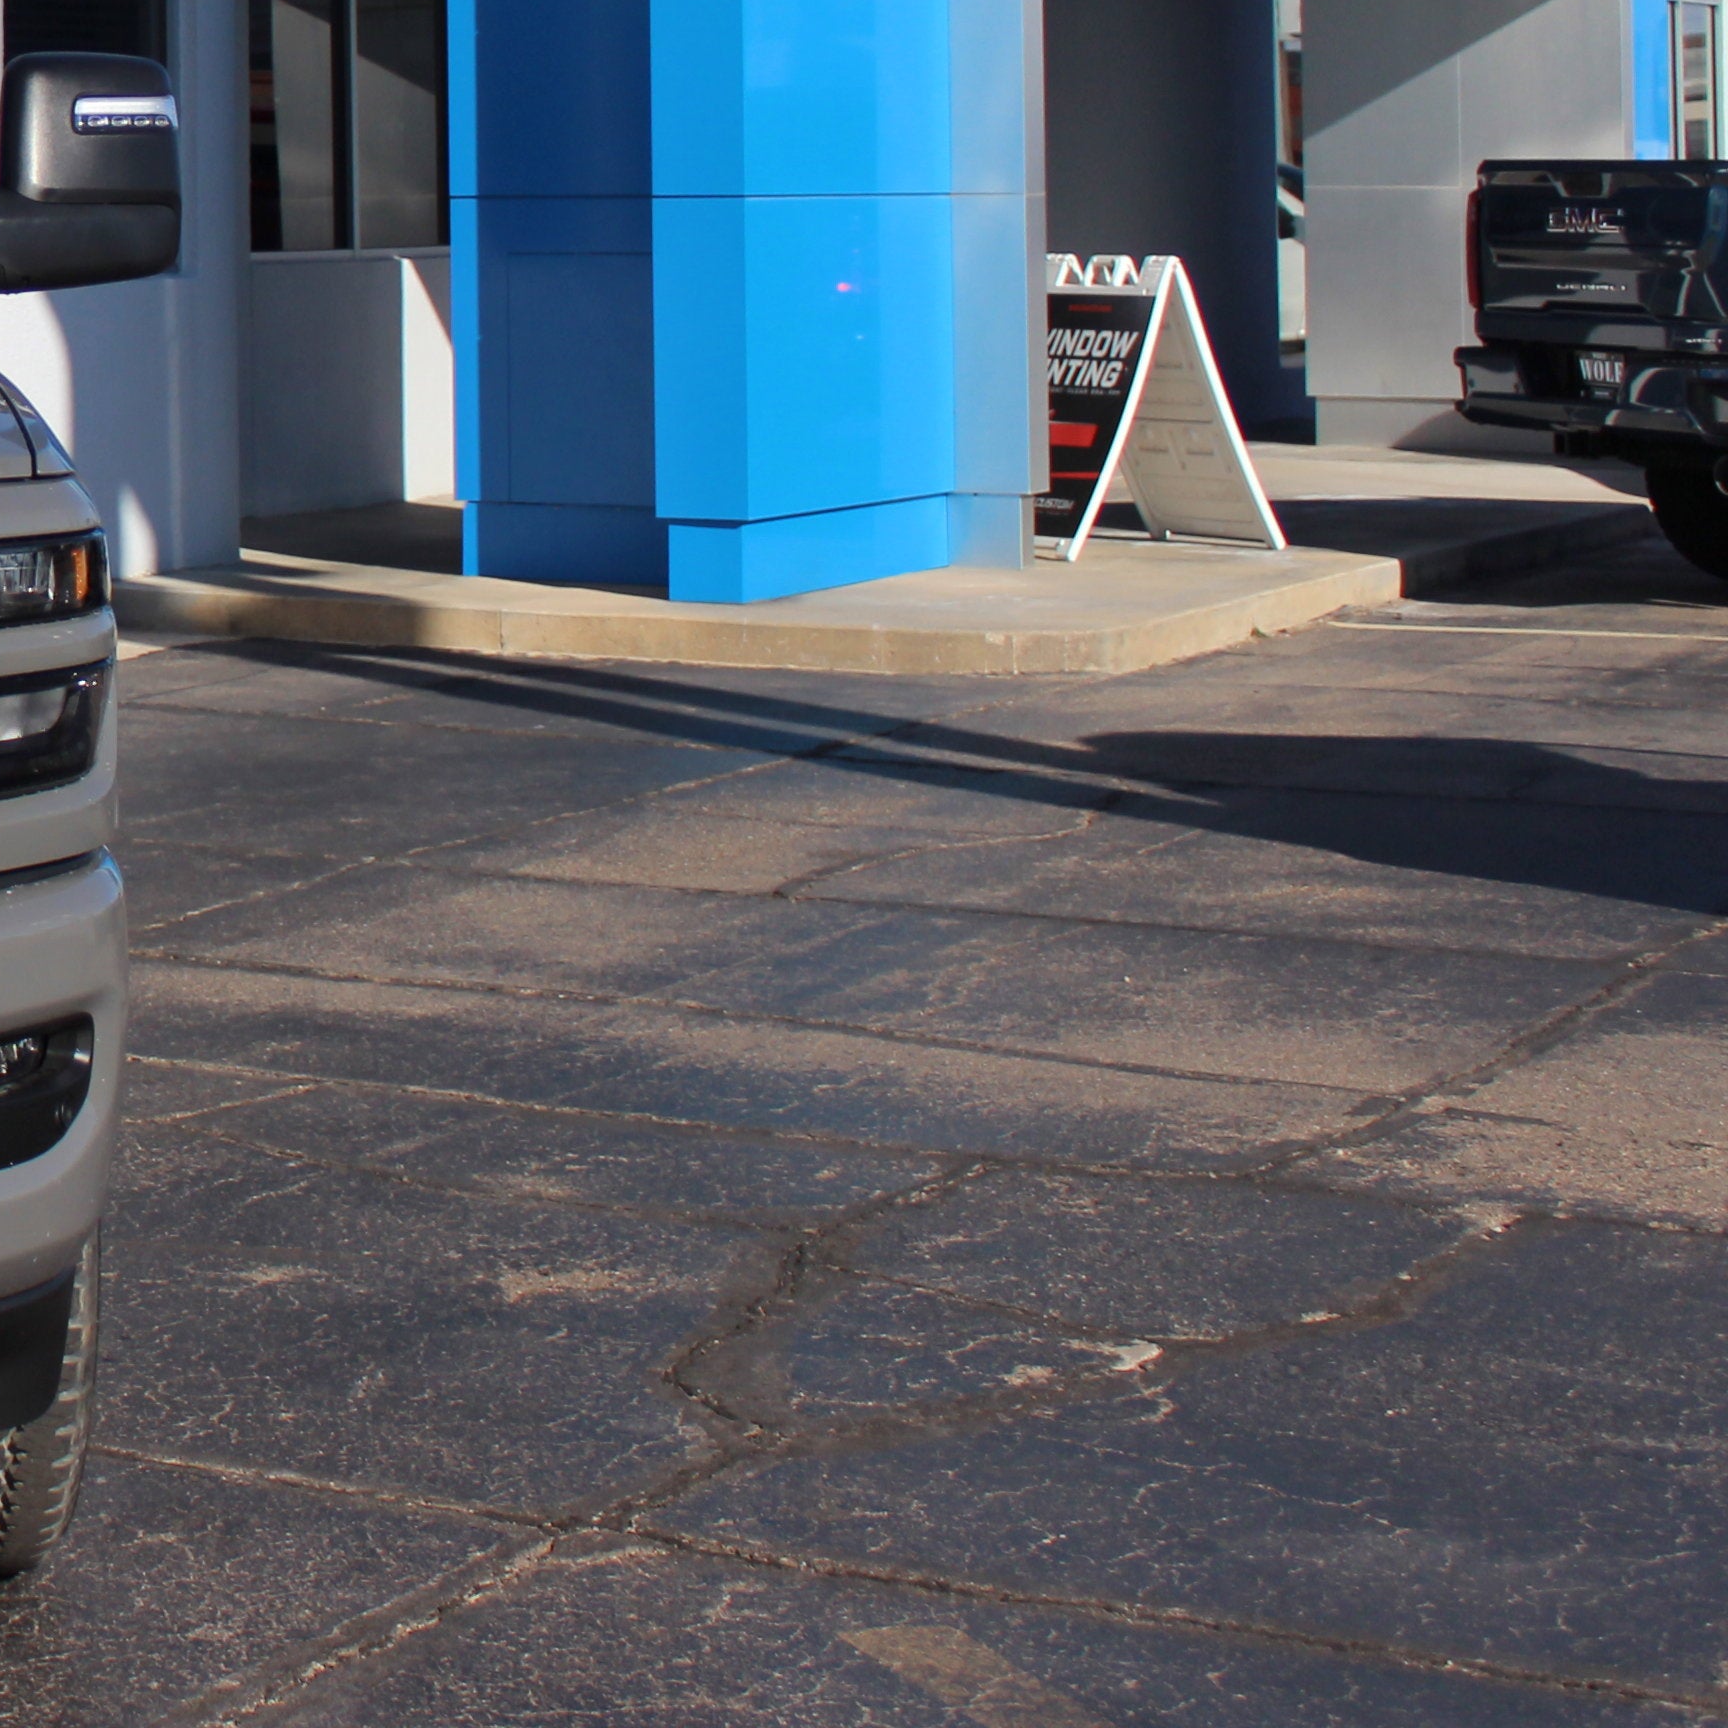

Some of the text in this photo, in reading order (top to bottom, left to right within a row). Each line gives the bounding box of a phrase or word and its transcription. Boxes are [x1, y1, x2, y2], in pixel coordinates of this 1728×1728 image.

[1546, 207, 1624, 234] GMC
[1047, 358, 1124, 389] NTING
[1579, 358, 1625, 384] WOLF
